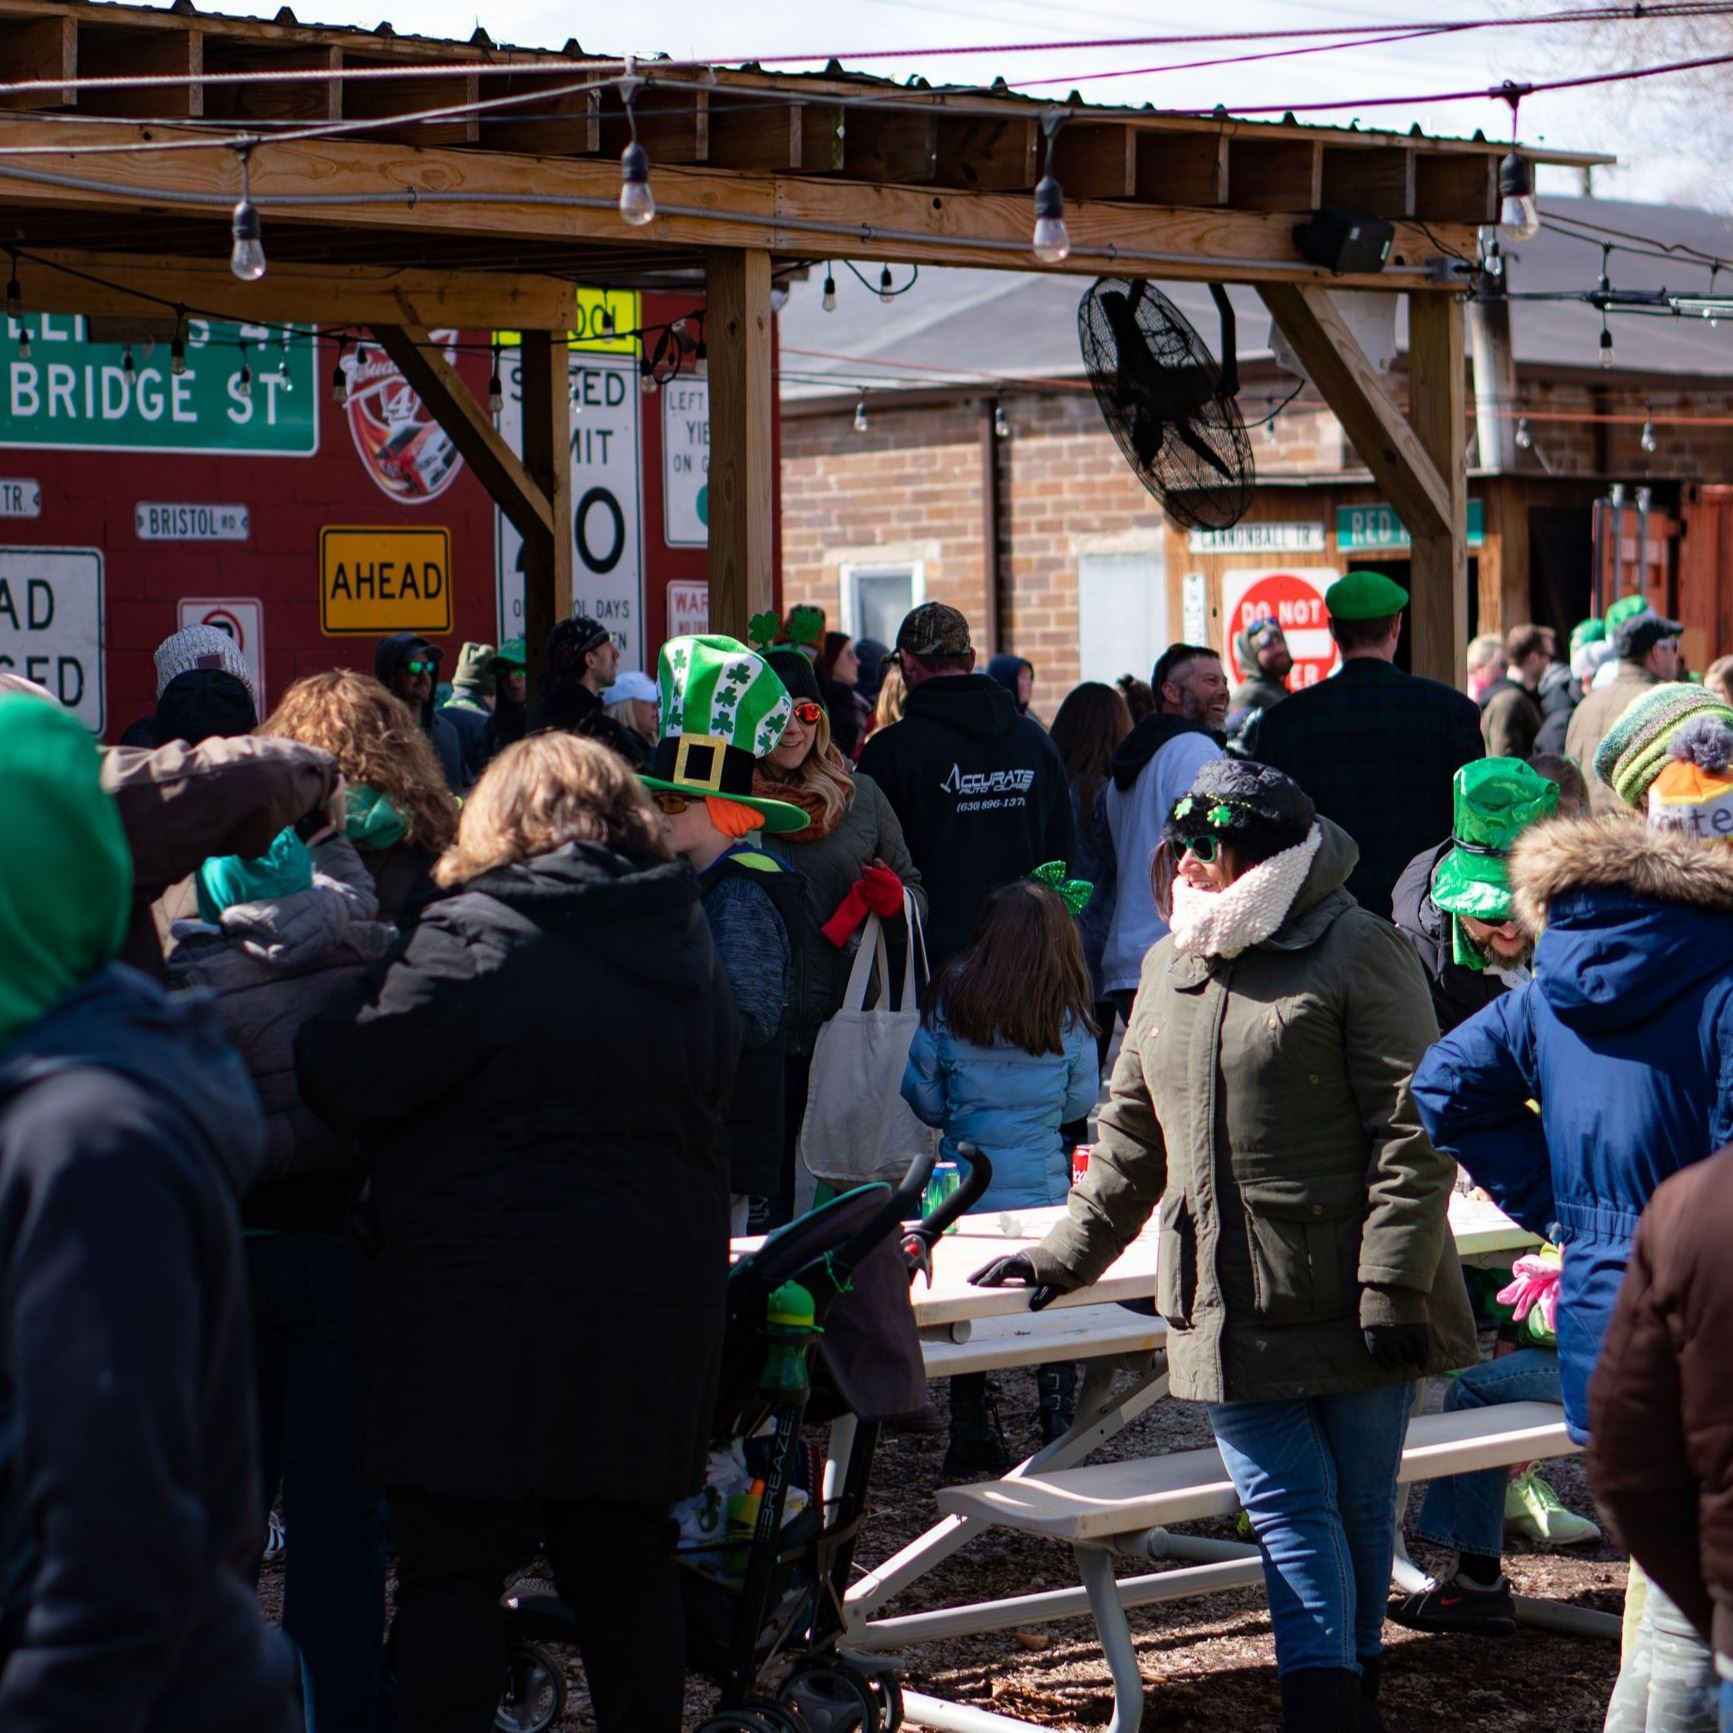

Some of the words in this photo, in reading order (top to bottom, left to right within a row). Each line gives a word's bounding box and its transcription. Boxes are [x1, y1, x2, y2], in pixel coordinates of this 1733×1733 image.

[9, 362, 198, 423] BRIDGE
[226, 371, 289, 426] ST
[668, 392, 704, 411] LEFT
[686, 421, 710, 446] YIE
[673, 454, 692, 473] ON
[149, 508, 219, 536] BRISTOL
[221, 514, 236, 530] RD
[1351, 511, 1391, 545] RED
[1200, 525, 1290, 549] CANNONBALL
[330, 562, 442, 601] AHEAD
[596, 600, 630, 619] DAYS
[1241, 600, 1272, 628] DO
[1278, 598, 1323, 625] NOT
[0, 654, 85, 708] ED
[938, 762, 1035, 794] ACCURATE
